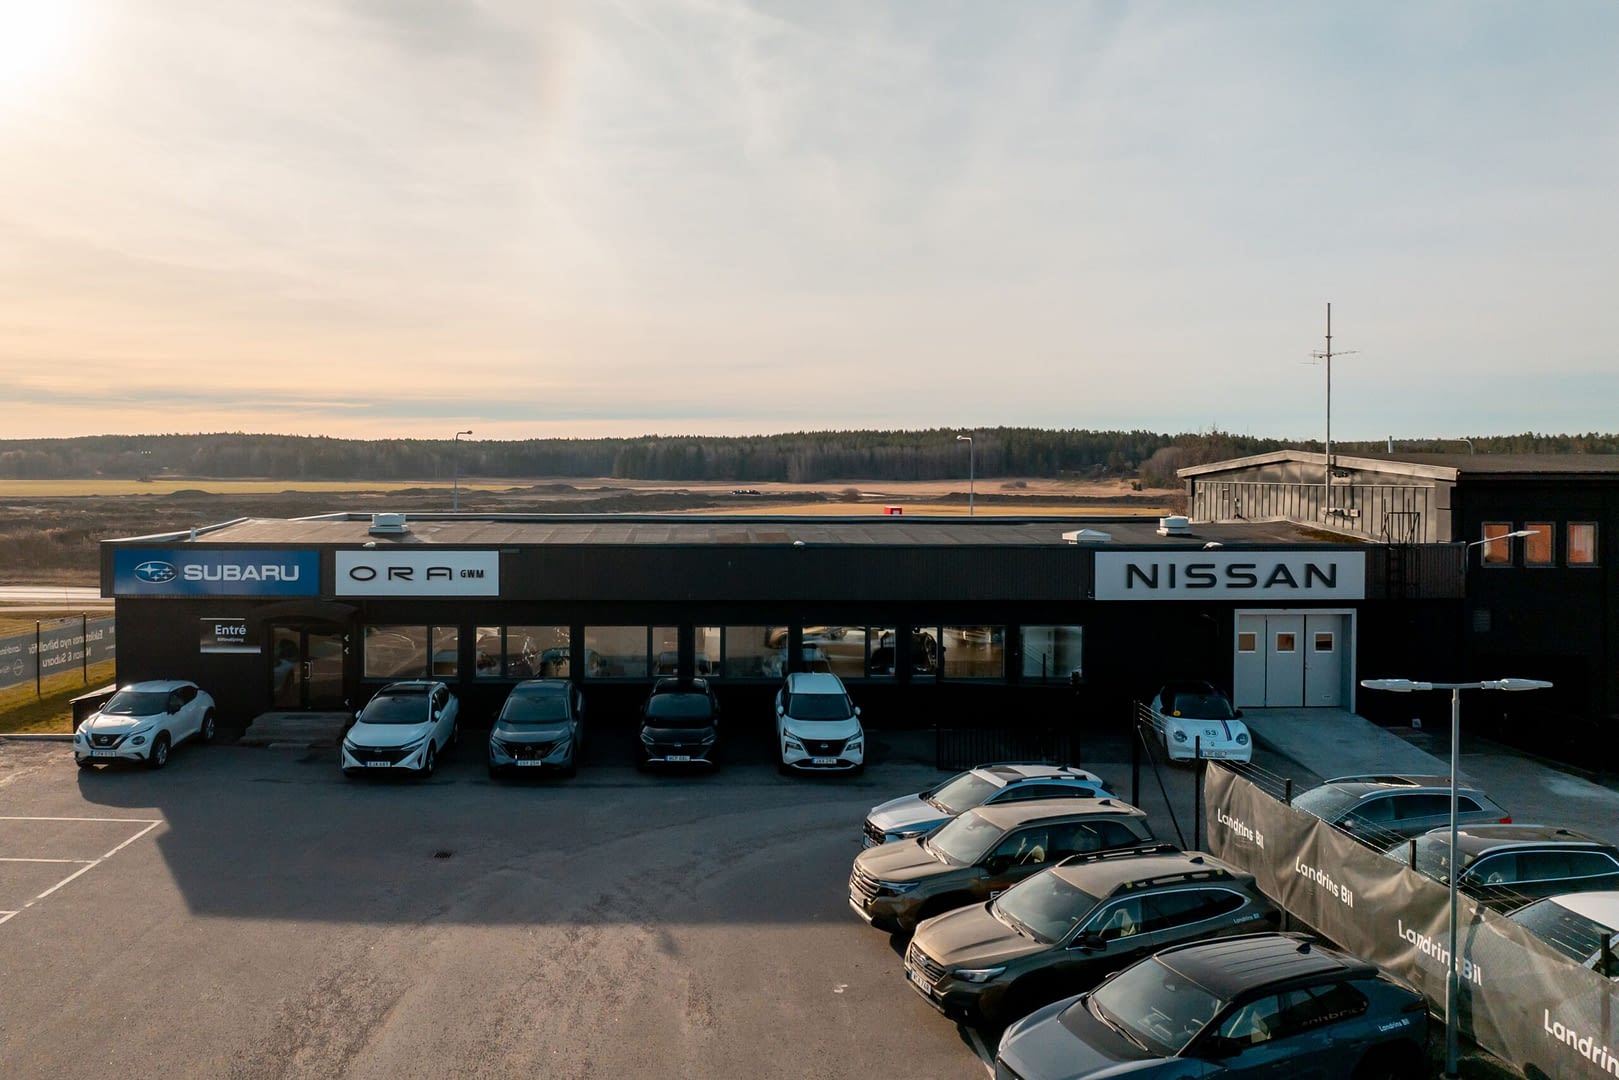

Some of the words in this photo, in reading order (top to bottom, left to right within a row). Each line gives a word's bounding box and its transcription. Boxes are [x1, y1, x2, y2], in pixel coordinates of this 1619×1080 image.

[183, 564, 300, 582] SUBARU
[349, 565, 453, 581] ORA
[460, 569, 485, 579] GWM
[1125, 563, 1337, 589] NISSAN
[215, 624, 247, 635] Entré
[1217, 808, 1254, 841] Landrins
[1255, 830, 1264, 849] Bil
[1295, 856, 1339, 897] Landrins
[1340, 884, 1353, 908] Bil
[1462, 958, 1482, 986] Bil
